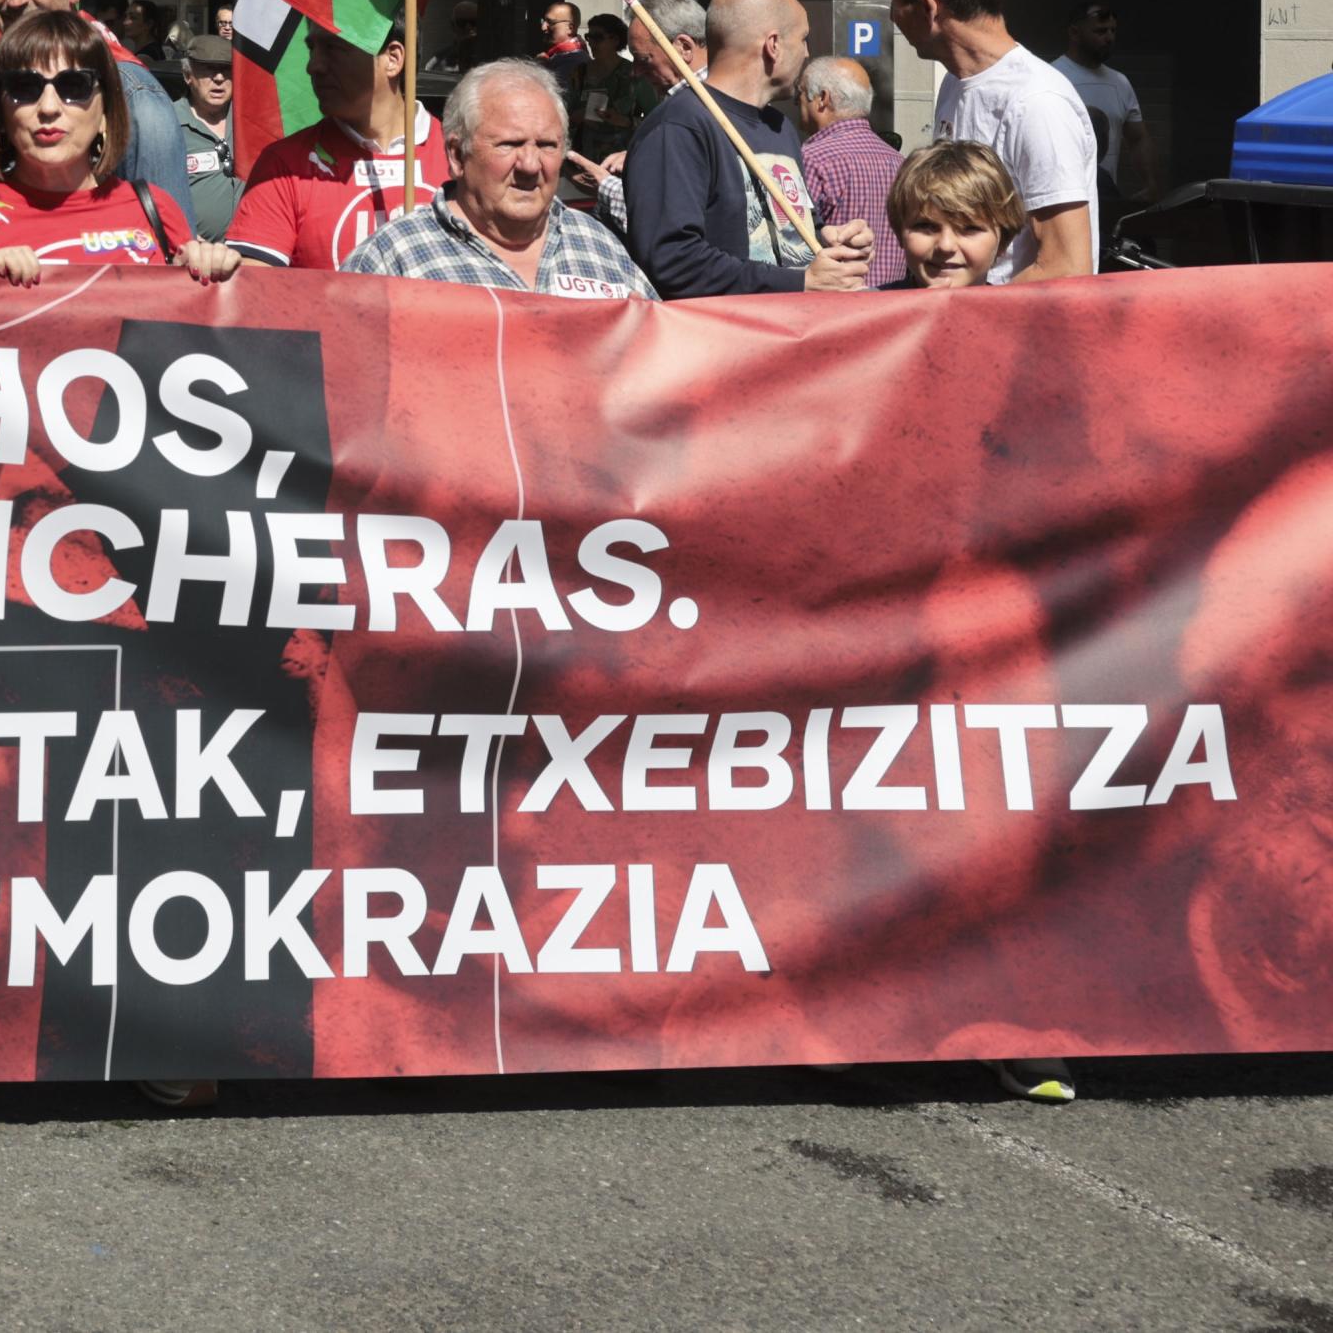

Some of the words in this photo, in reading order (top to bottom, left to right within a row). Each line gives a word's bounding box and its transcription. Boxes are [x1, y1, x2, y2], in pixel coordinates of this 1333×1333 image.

[854, 22, 874, 54] P
[83, 230, 130, 253] UGT
[557, 276, 596, 294] UGT
[349, 702, 1238, 815] ETXEBIZITZA
